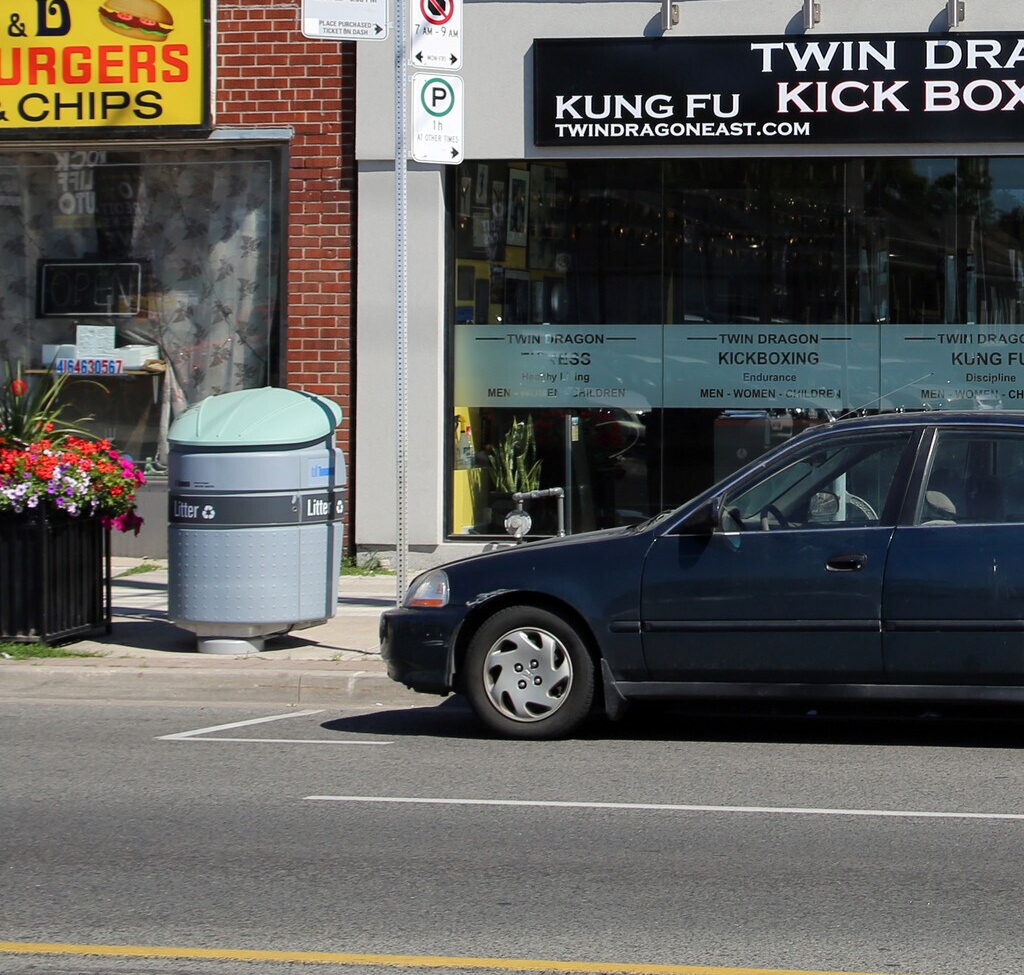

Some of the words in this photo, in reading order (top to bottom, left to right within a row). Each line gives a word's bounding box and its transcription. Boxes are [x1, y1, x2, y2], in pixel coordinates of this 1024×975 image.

[7, 13, 28, 37] &
[338, 20, 371, 28] PURCHASED
[422, 27, 432, 35] AM
[440, 26, 447, 36] 9
[448, 29, 458, 37] AM
[750, 40, 896, 73] TWIN
[777, 80, 910, 114] KICK
[17, 90, 163, 122] CHIPS
[555, 94, 675, 120] KUNG
[686, 93, 741, 119] FU
[555, 121, 810, 138] TWINDRAGONEAST.COM
[51, 272, 132, 306] OPEN
[507, 334, 542, 344] TWIN
[545, 334, 604, 345] DRAGON
[719, 334, 754, 344] TWIN
[758, 334, 819, 345] DRAGON
[937, 334, 973, 344] TWIN
[719, 352, 820, 366] KICKBOXING
[952, 352, 1002, 366] KUNG
[743, 372, 797, 382] Endurance
[966, 372, 1016, 384] Discipline
[488, 388, 511, 398] MEN
[700, 389, 724, 398] MEN
[733, 389, 776, 398] WOMEN
[785, 389, 842, 399] CHILDREN
[921, 389, 945, 399] MEN
[174, 500, 199, 518] Litter
[307, 498, 332, 516] Litter
